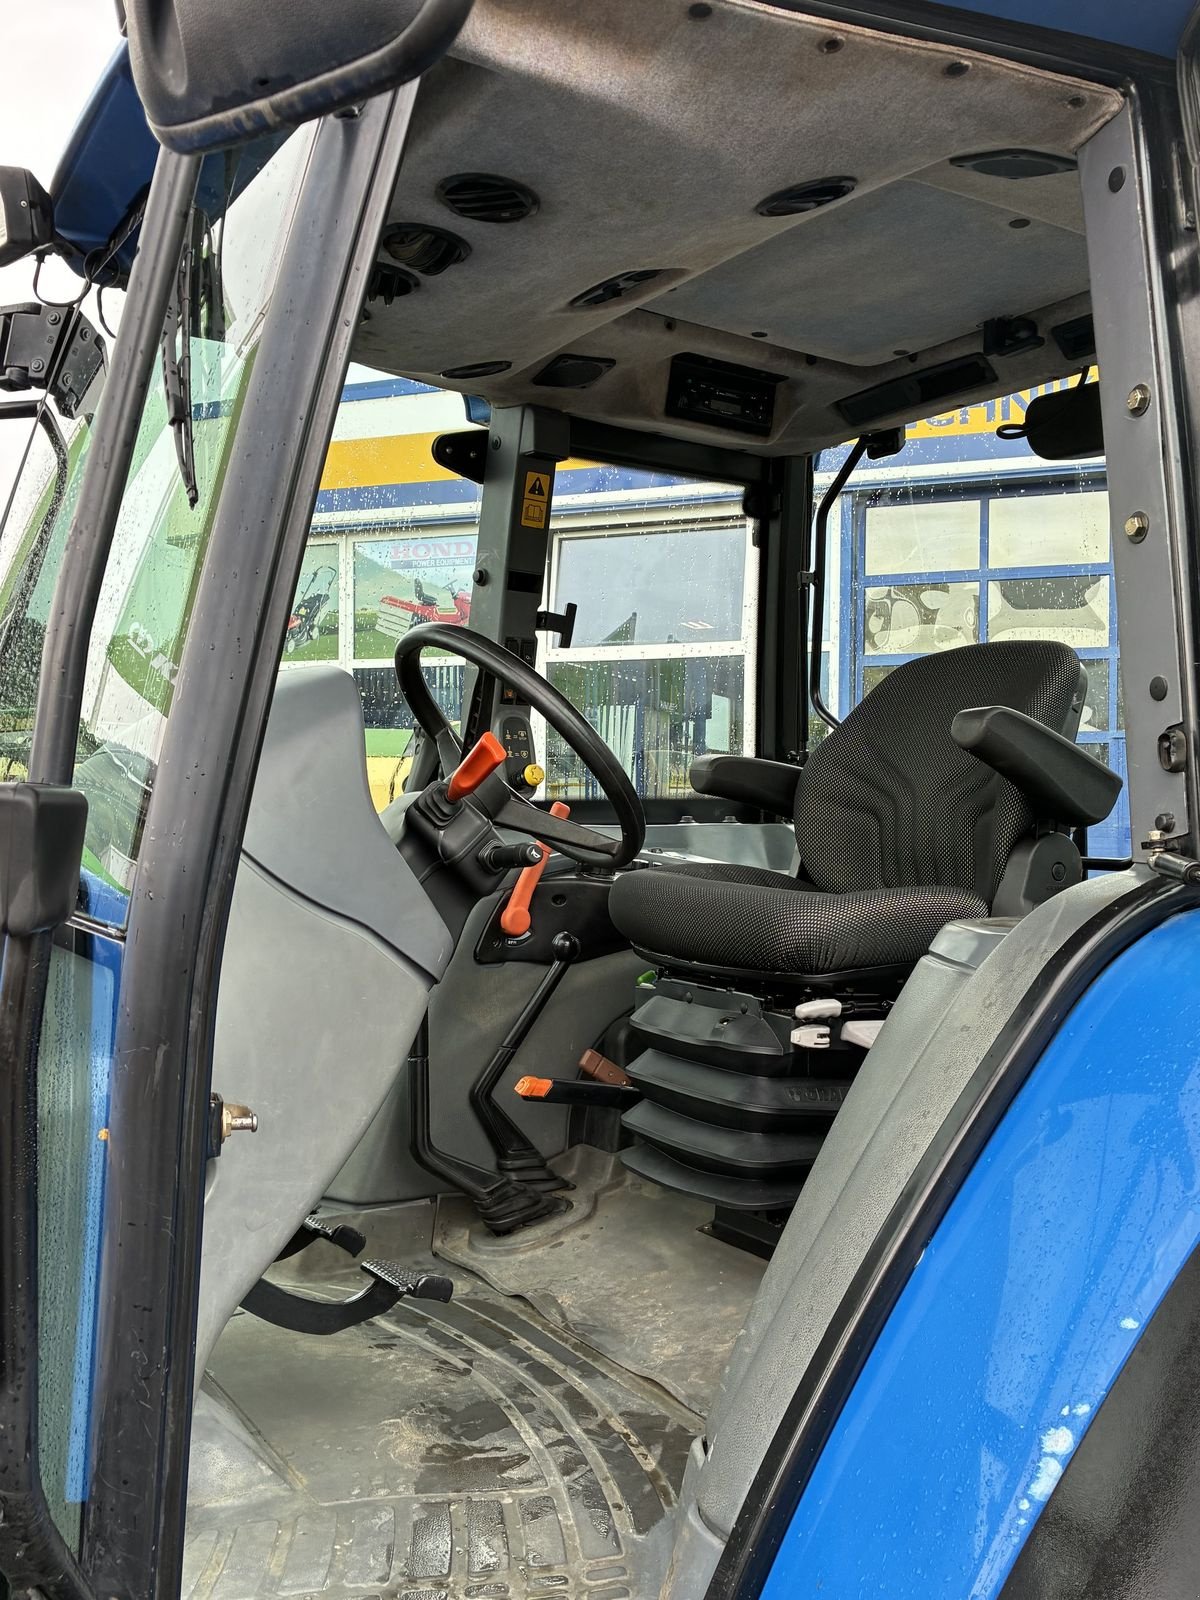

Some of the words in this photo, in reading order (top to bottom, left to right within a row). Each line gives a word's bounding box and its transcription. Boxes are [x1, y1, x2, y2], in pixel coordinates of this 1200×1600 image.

[390, 541, 474, 559] HOND
[412, 559, 435, 567] POWER
[436, 558, 472, 567] EQUIPMENT
